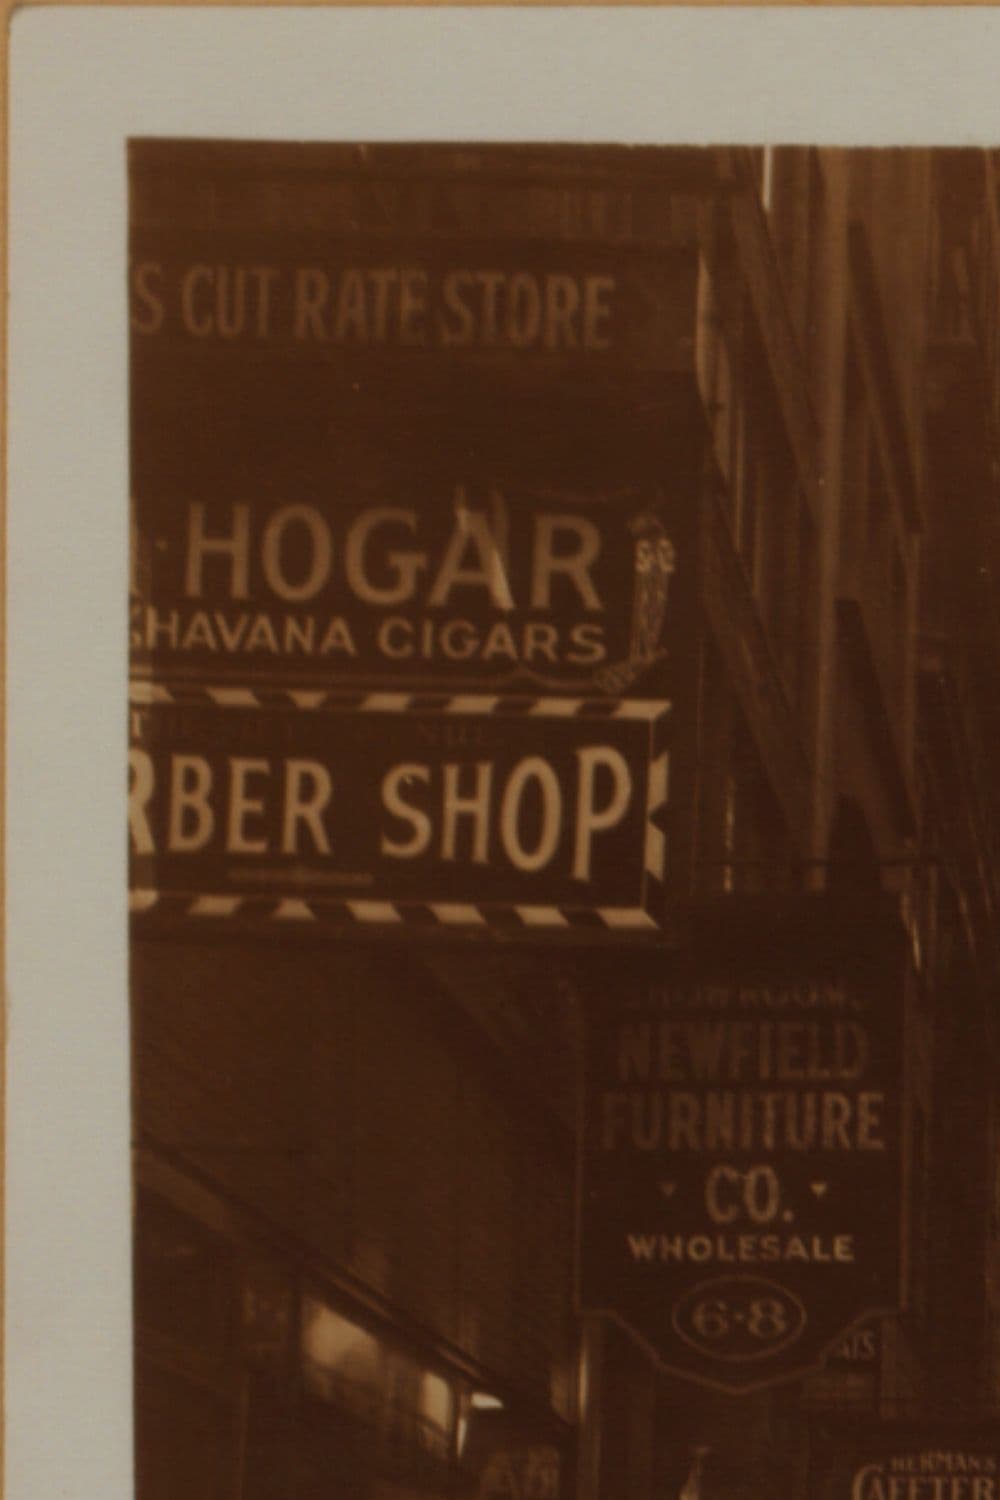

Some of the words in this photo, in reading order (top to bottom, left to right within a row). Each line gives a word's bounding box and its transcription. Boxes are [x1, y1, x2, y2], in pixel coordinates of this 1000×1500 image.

[181, 263, 279, 340] CUT
[294, 265, 428, 345] RATE
[440, 269, 616, 351] STORE
[184, 498, 604, 612] HOGAR
[376, 616, 608, 665] CIGARS
[379, 743, 634, 884] SHOP
[617, 1020, 871, 1082] NEWFIELD
[602, 1089, 887, 1153] FURNITURE
[703, 1163, 796, 1225] CO.
[626, 1232, 857, 1263] WHOLESALE
